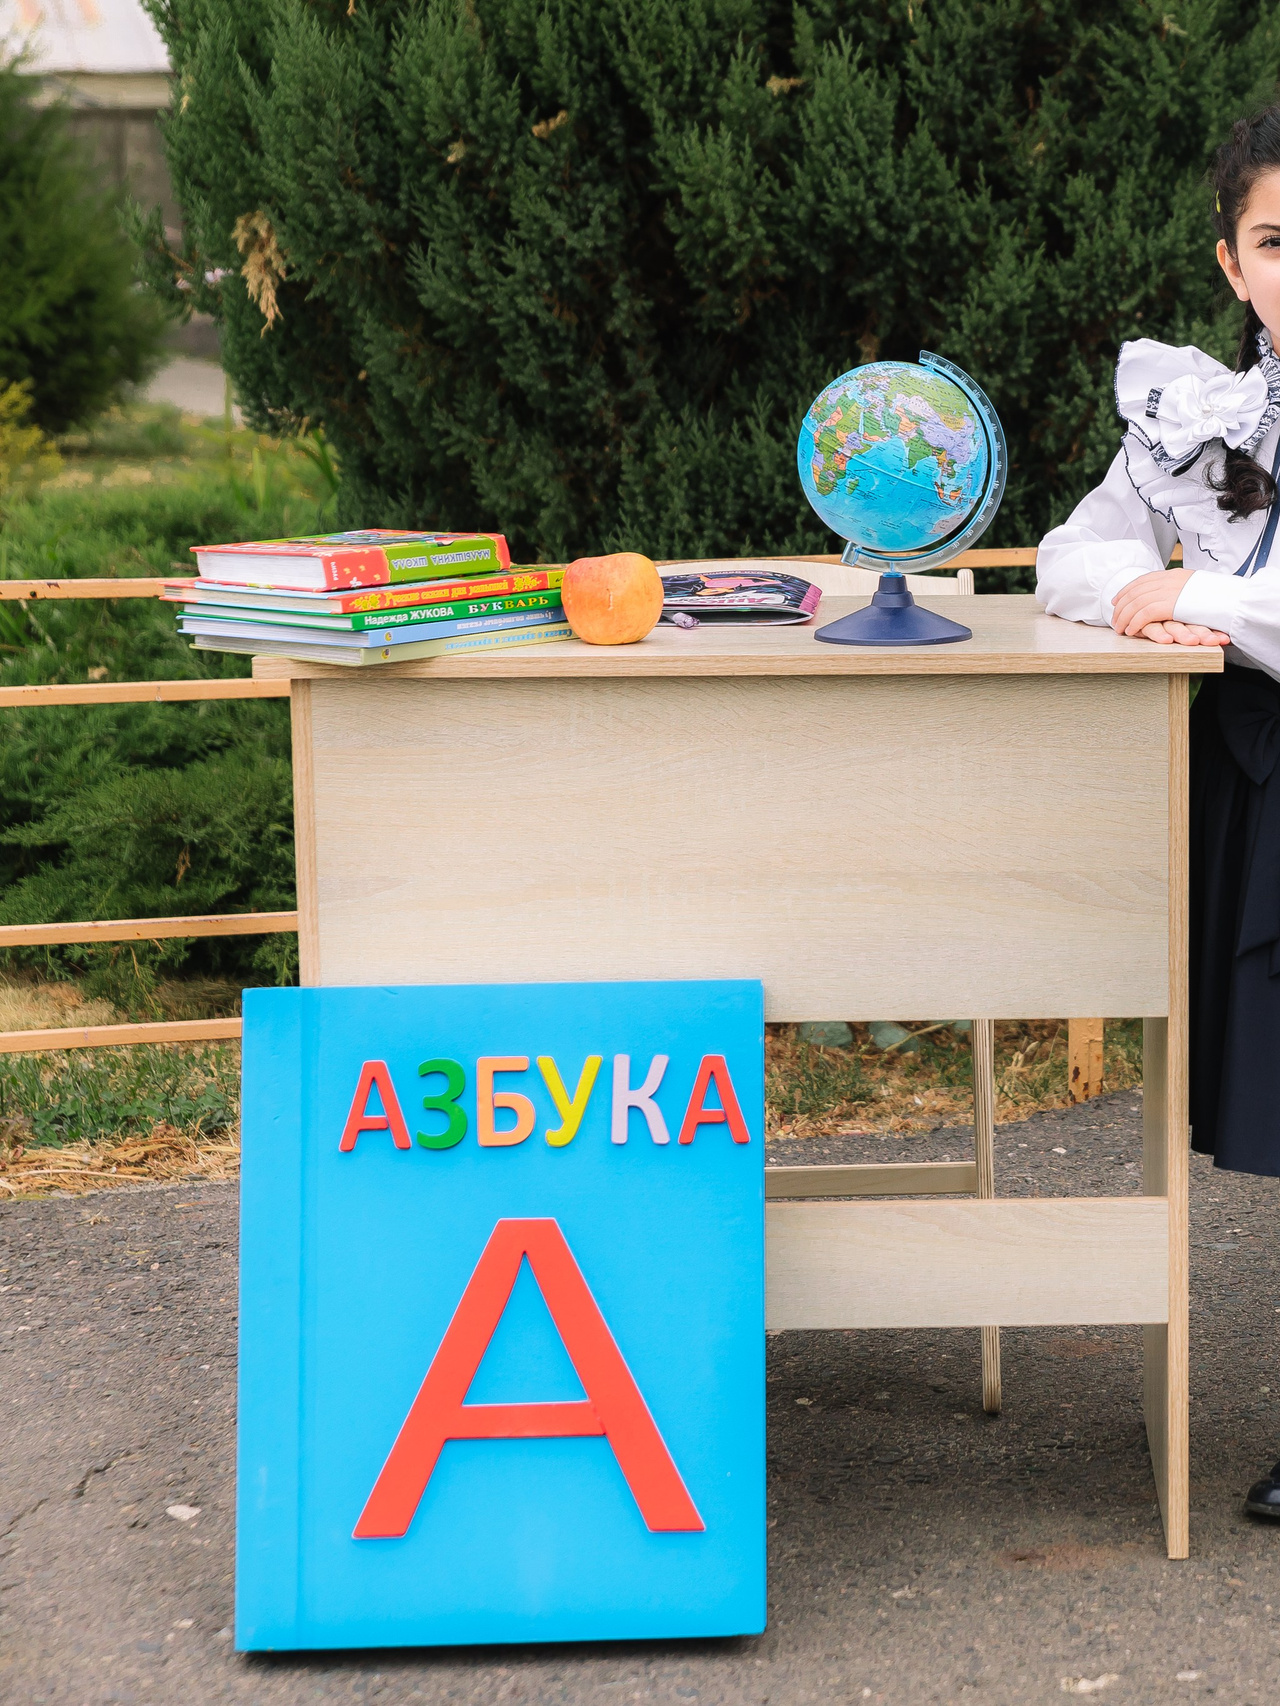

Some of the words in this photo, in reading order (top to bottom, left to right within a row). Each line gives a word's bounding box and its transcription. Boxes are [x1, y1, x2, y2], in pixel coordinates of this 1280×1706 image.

[392, 556, 428, 570] ШКОЛА
[430, 549, 491, 566] МАЛЫШКИНА
[468, 596, 549, 614] БУКВАРЬ
[364, 613, 408, 626] Надежда
[409, 606, 454, 620] ЖУКОВА
[338, 1054, 751, 1152] АЗБУКА
[351, 1217, 706, 1539] А
